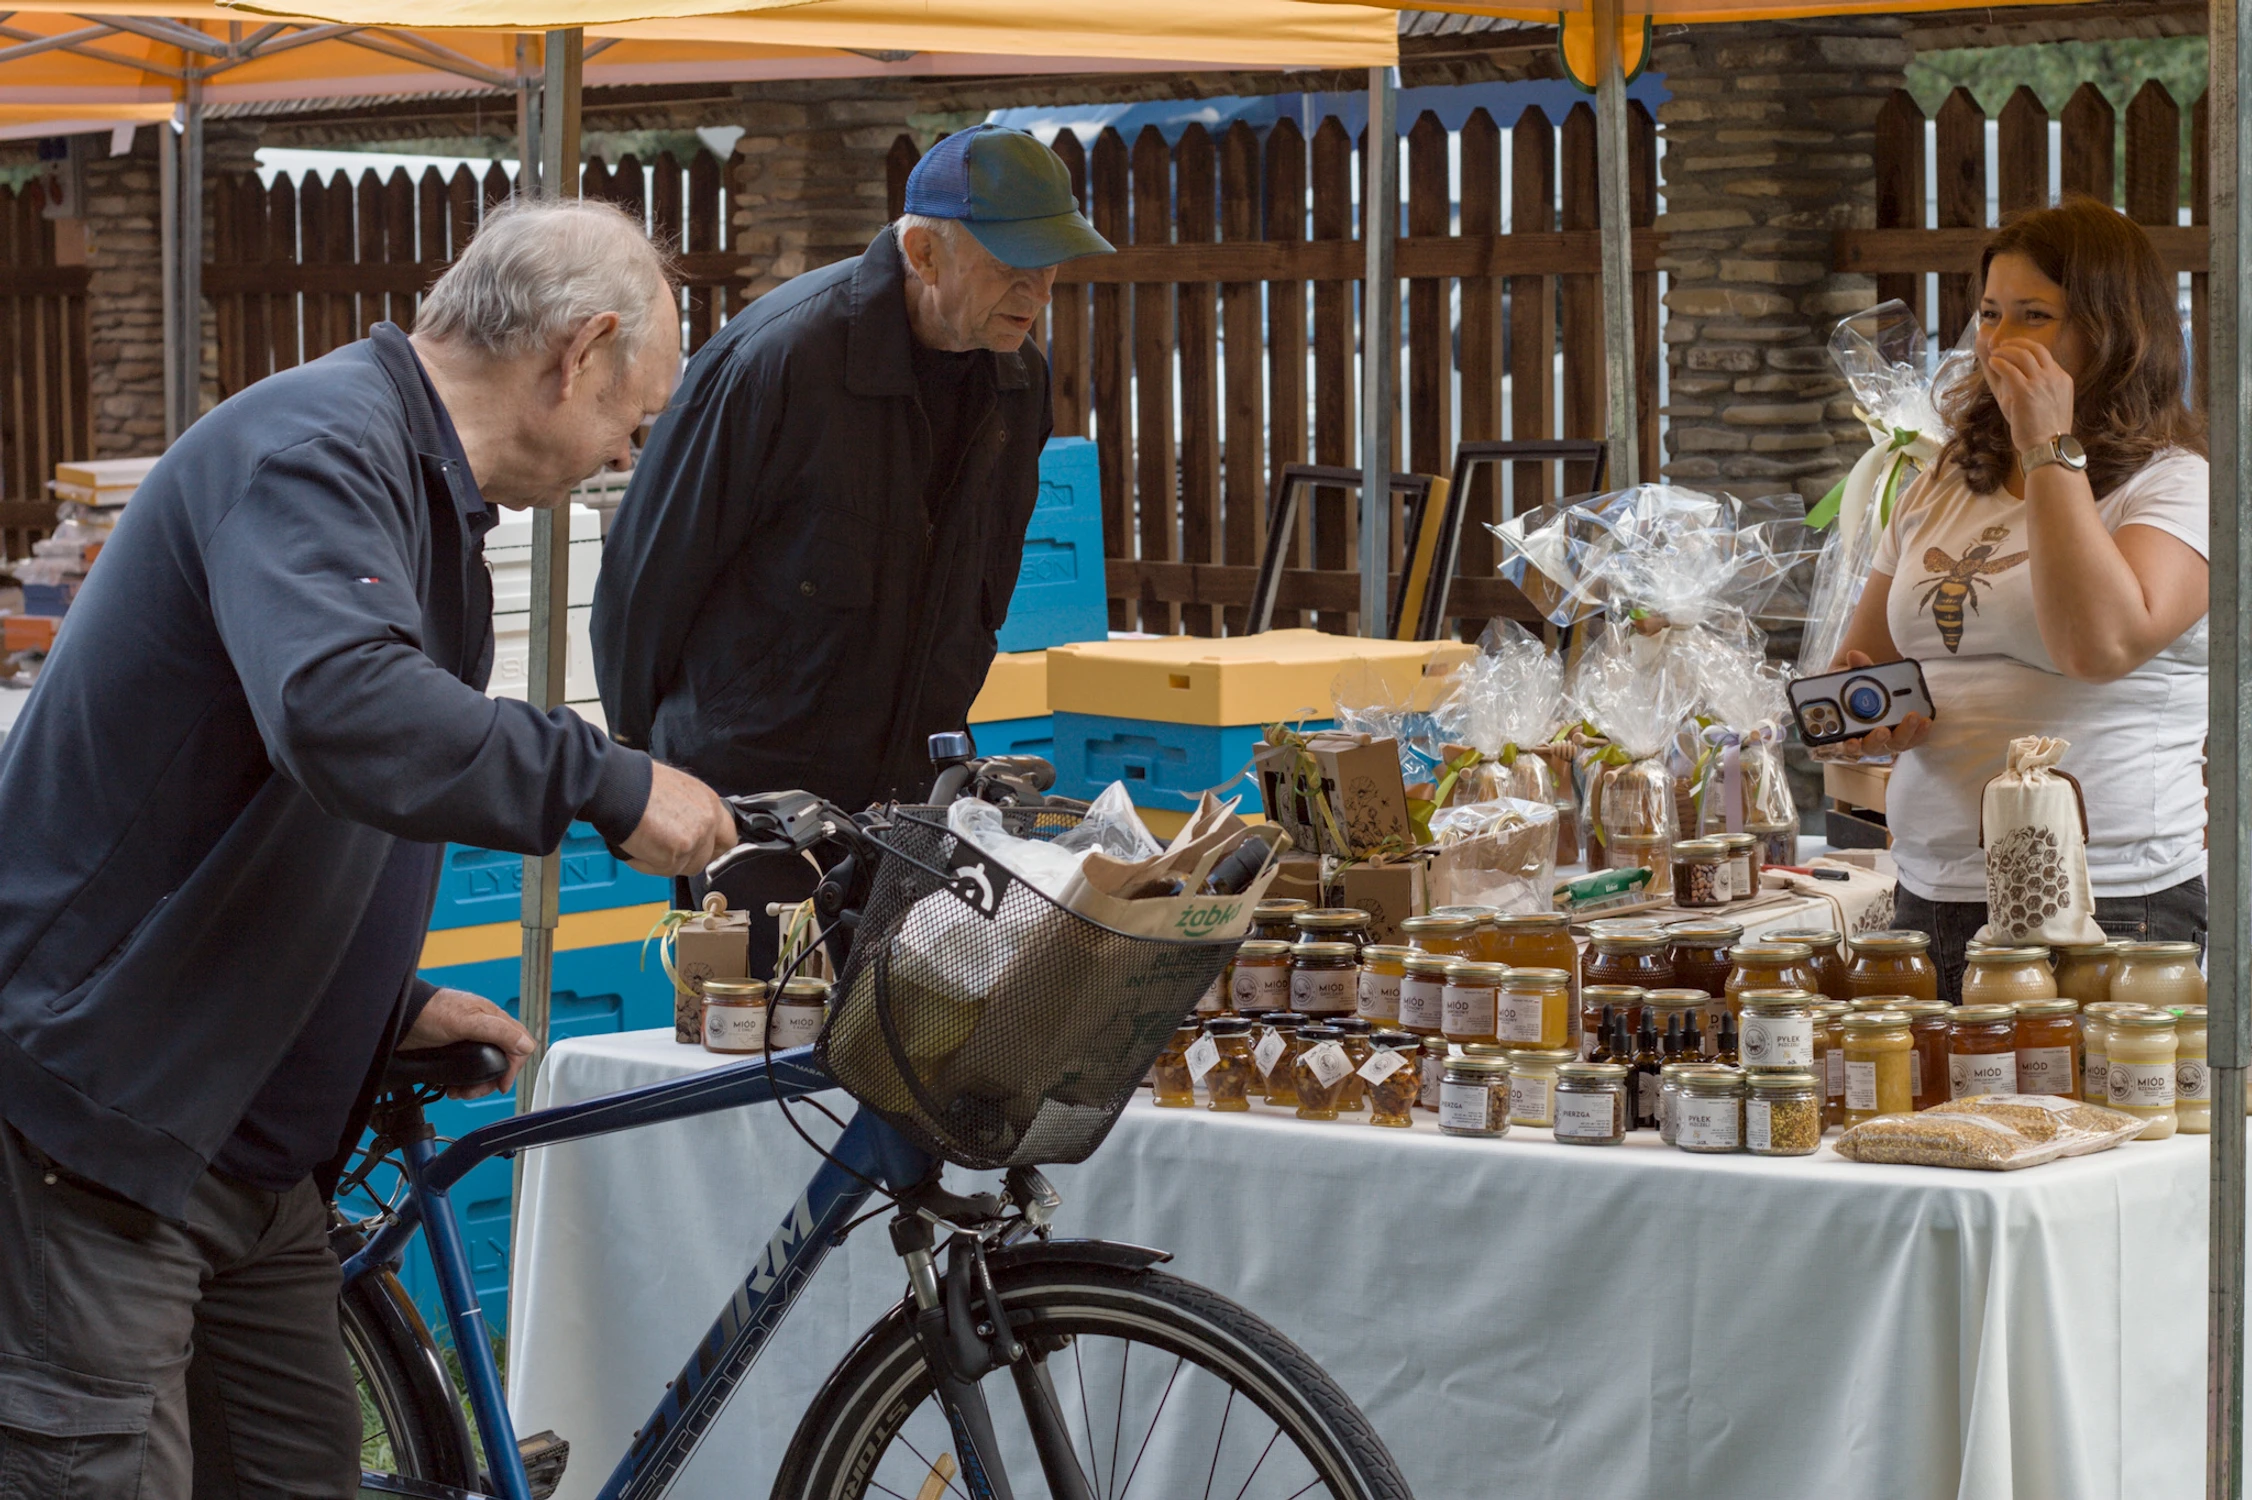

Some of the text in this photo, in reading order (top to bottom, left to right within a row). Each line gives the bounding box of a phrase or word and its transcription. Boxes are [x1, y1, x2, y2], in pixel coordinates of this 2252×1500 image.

[1021, 556, 1071, 581] SON
[468, 857, 592, 897] LYSN
[1264, 979, 1288, 989] MIÓD
[1319, 982, 1344, 992] MIÓD
[1381, 987, 1400, 997] MIÓ
[1447, 1000, 1469, 1011] MIÓD
[733, 1018, 756, 1029] MIÓD
[789, 1016, 814, 1027] MIÓD
[1777, 1035, 1800, 1043] PYŁEK
[2022, 1061, 2048, 1071] MIÓD
[1974, 1067, 2002, 1077] MIÓD
[2138, 1076, 2165, 1086] MIÓD
[1562, 1110, 1590, 1118] PIERZGA
[1688, 1115, 1711, 1123] PYŁEK
[631, 1187, 815, 1477] STORM
